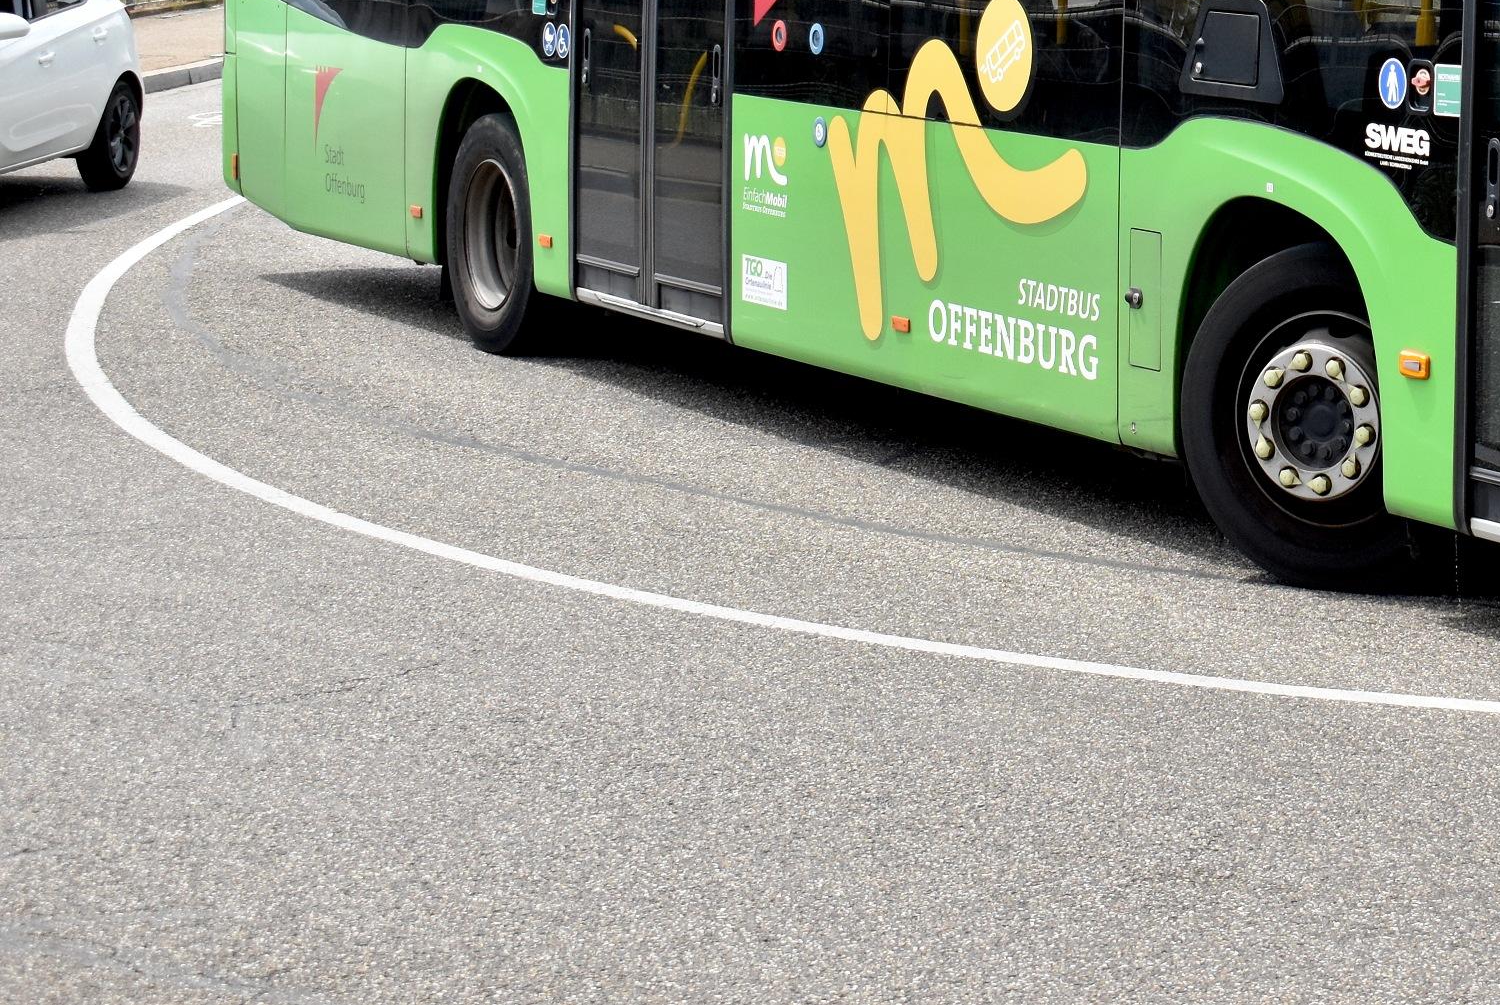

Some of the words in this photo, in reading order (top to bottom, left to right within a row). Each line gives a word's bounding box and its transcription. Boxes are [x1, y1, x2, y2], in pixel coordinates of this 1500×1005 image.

[325, 143, 345, 166] Stadt
[1364, 122, 1430, 157] SWEG
[325, 173, 366, 204] Offenburg
[743, 186, 788, 209] EinfachMobil
[745, 257, 763, 278] TGO
[1018, 278, 1101, 322] STADTBUS
[928, 299, 1099, 381] OFFENBURG
